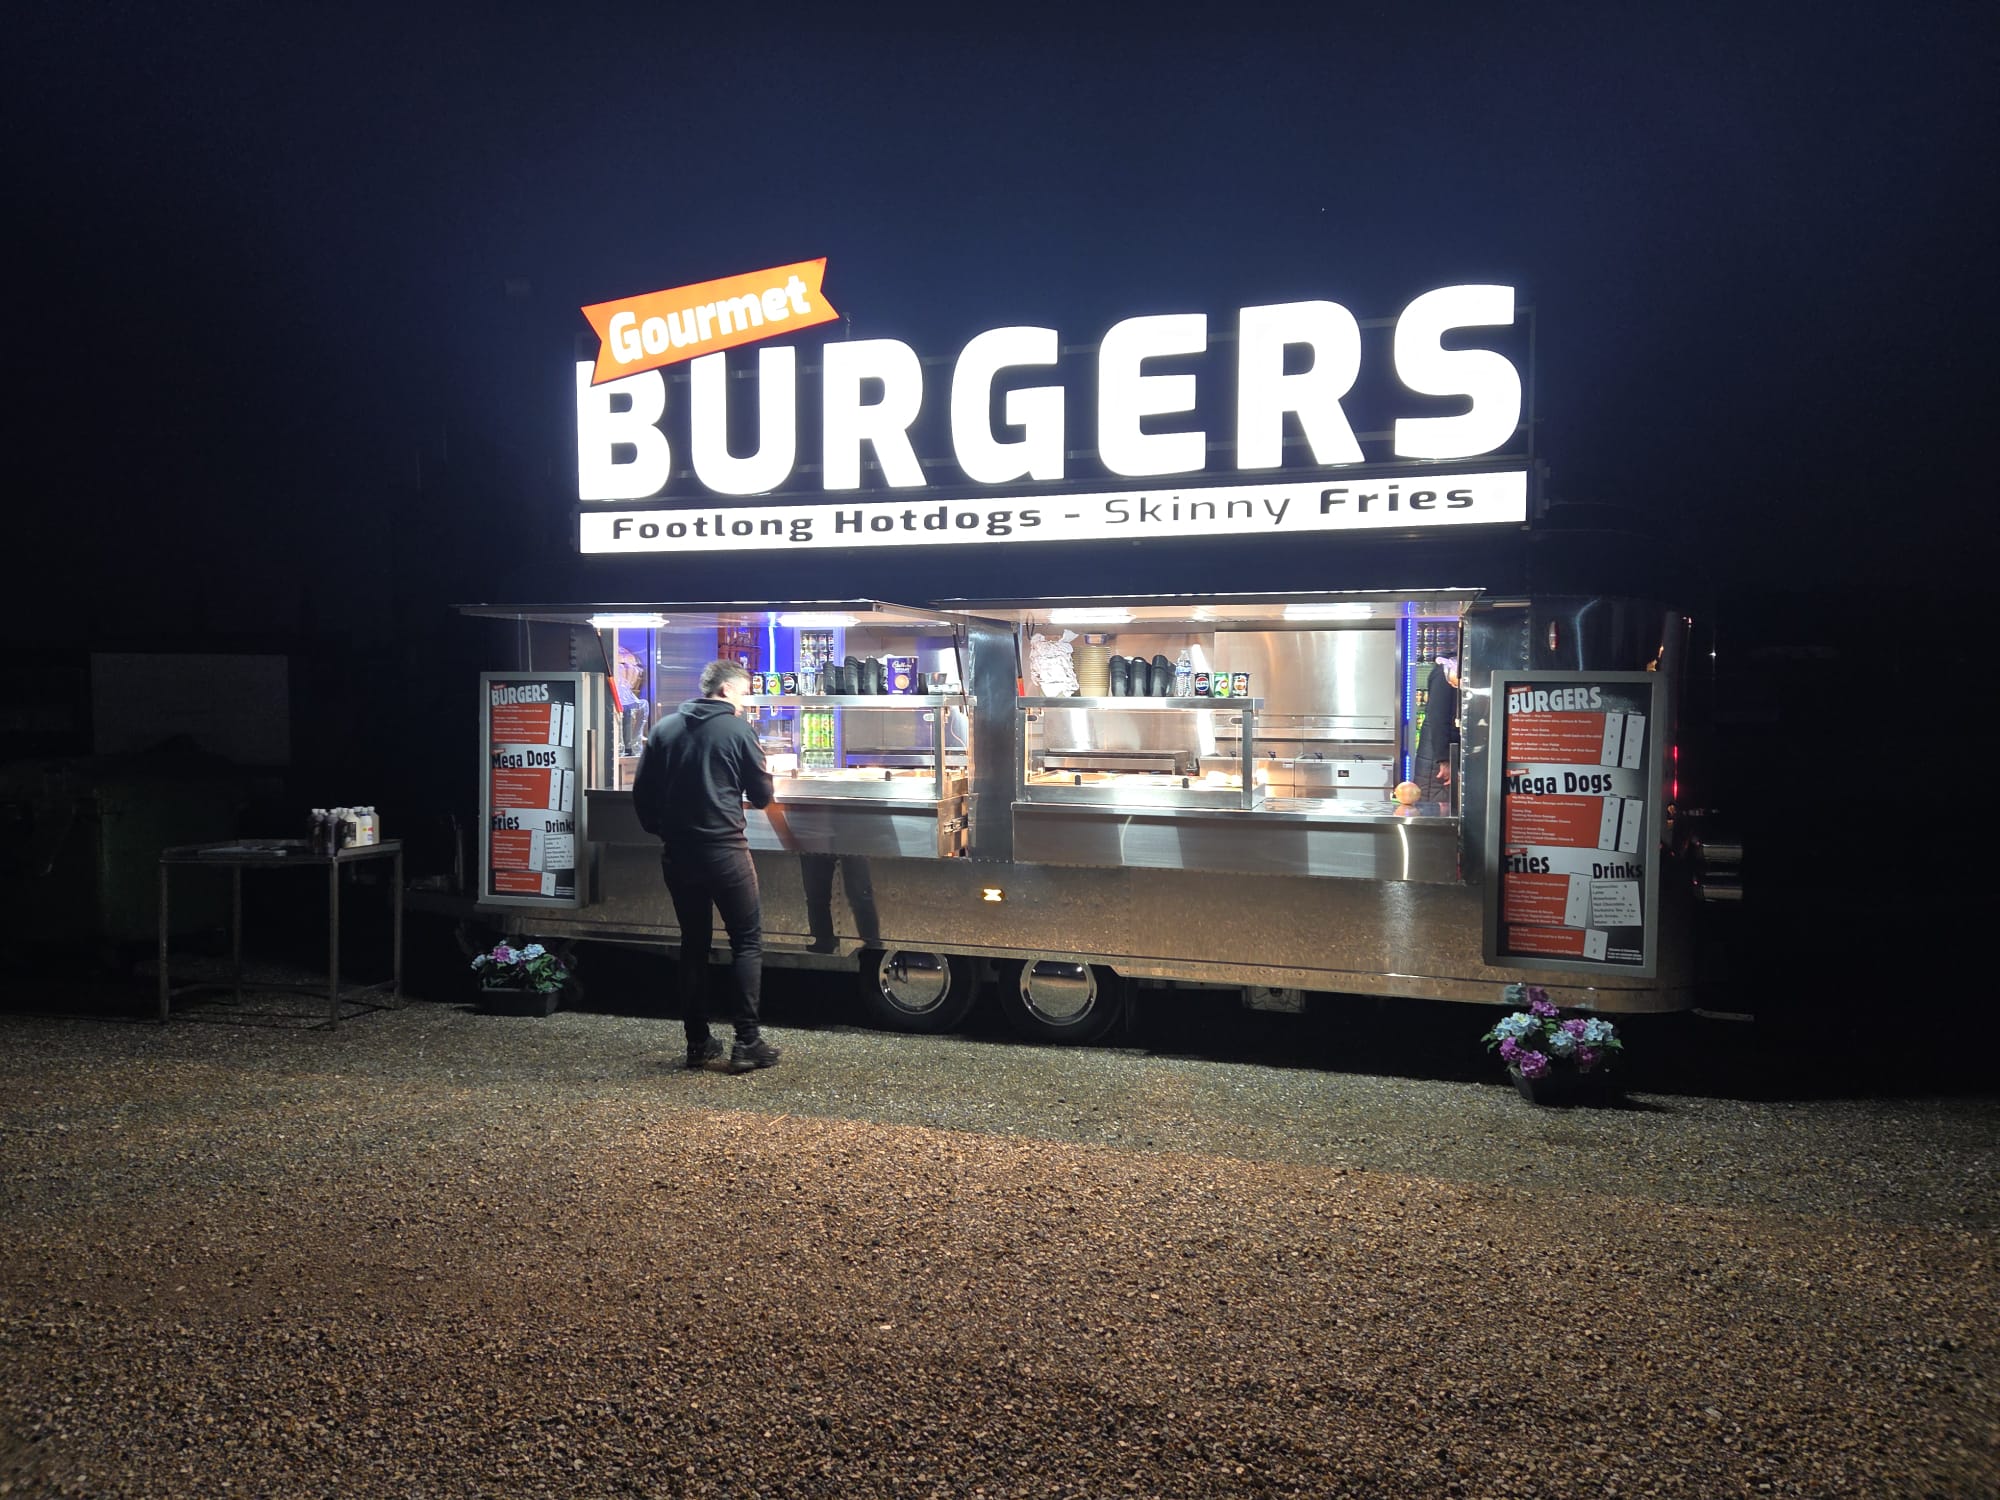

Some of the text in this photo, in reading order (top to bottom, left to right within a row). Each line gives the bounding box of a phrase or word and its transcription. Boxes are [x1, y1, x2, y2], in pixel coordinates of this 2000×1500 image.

[609, 275, 812, 365] Gourmet
[576, 284, 1522, 501] BURGERS
[613, 514, 814, 542] Footlong
[835, 506, 1041, 536] Hotdogs
[1105, 496, 1291, 525] Skinny
[1320, 485, 1475, 514] Fries
[491, 684, 549, 706] BURGERS
[1508, 686, 1602, 714] BURGERS
[526, 750, 557, 767] Dogs
[1504, 771, 1613, 796] Mega Dogs
[1592, 861, 1643, 879] Drinks
